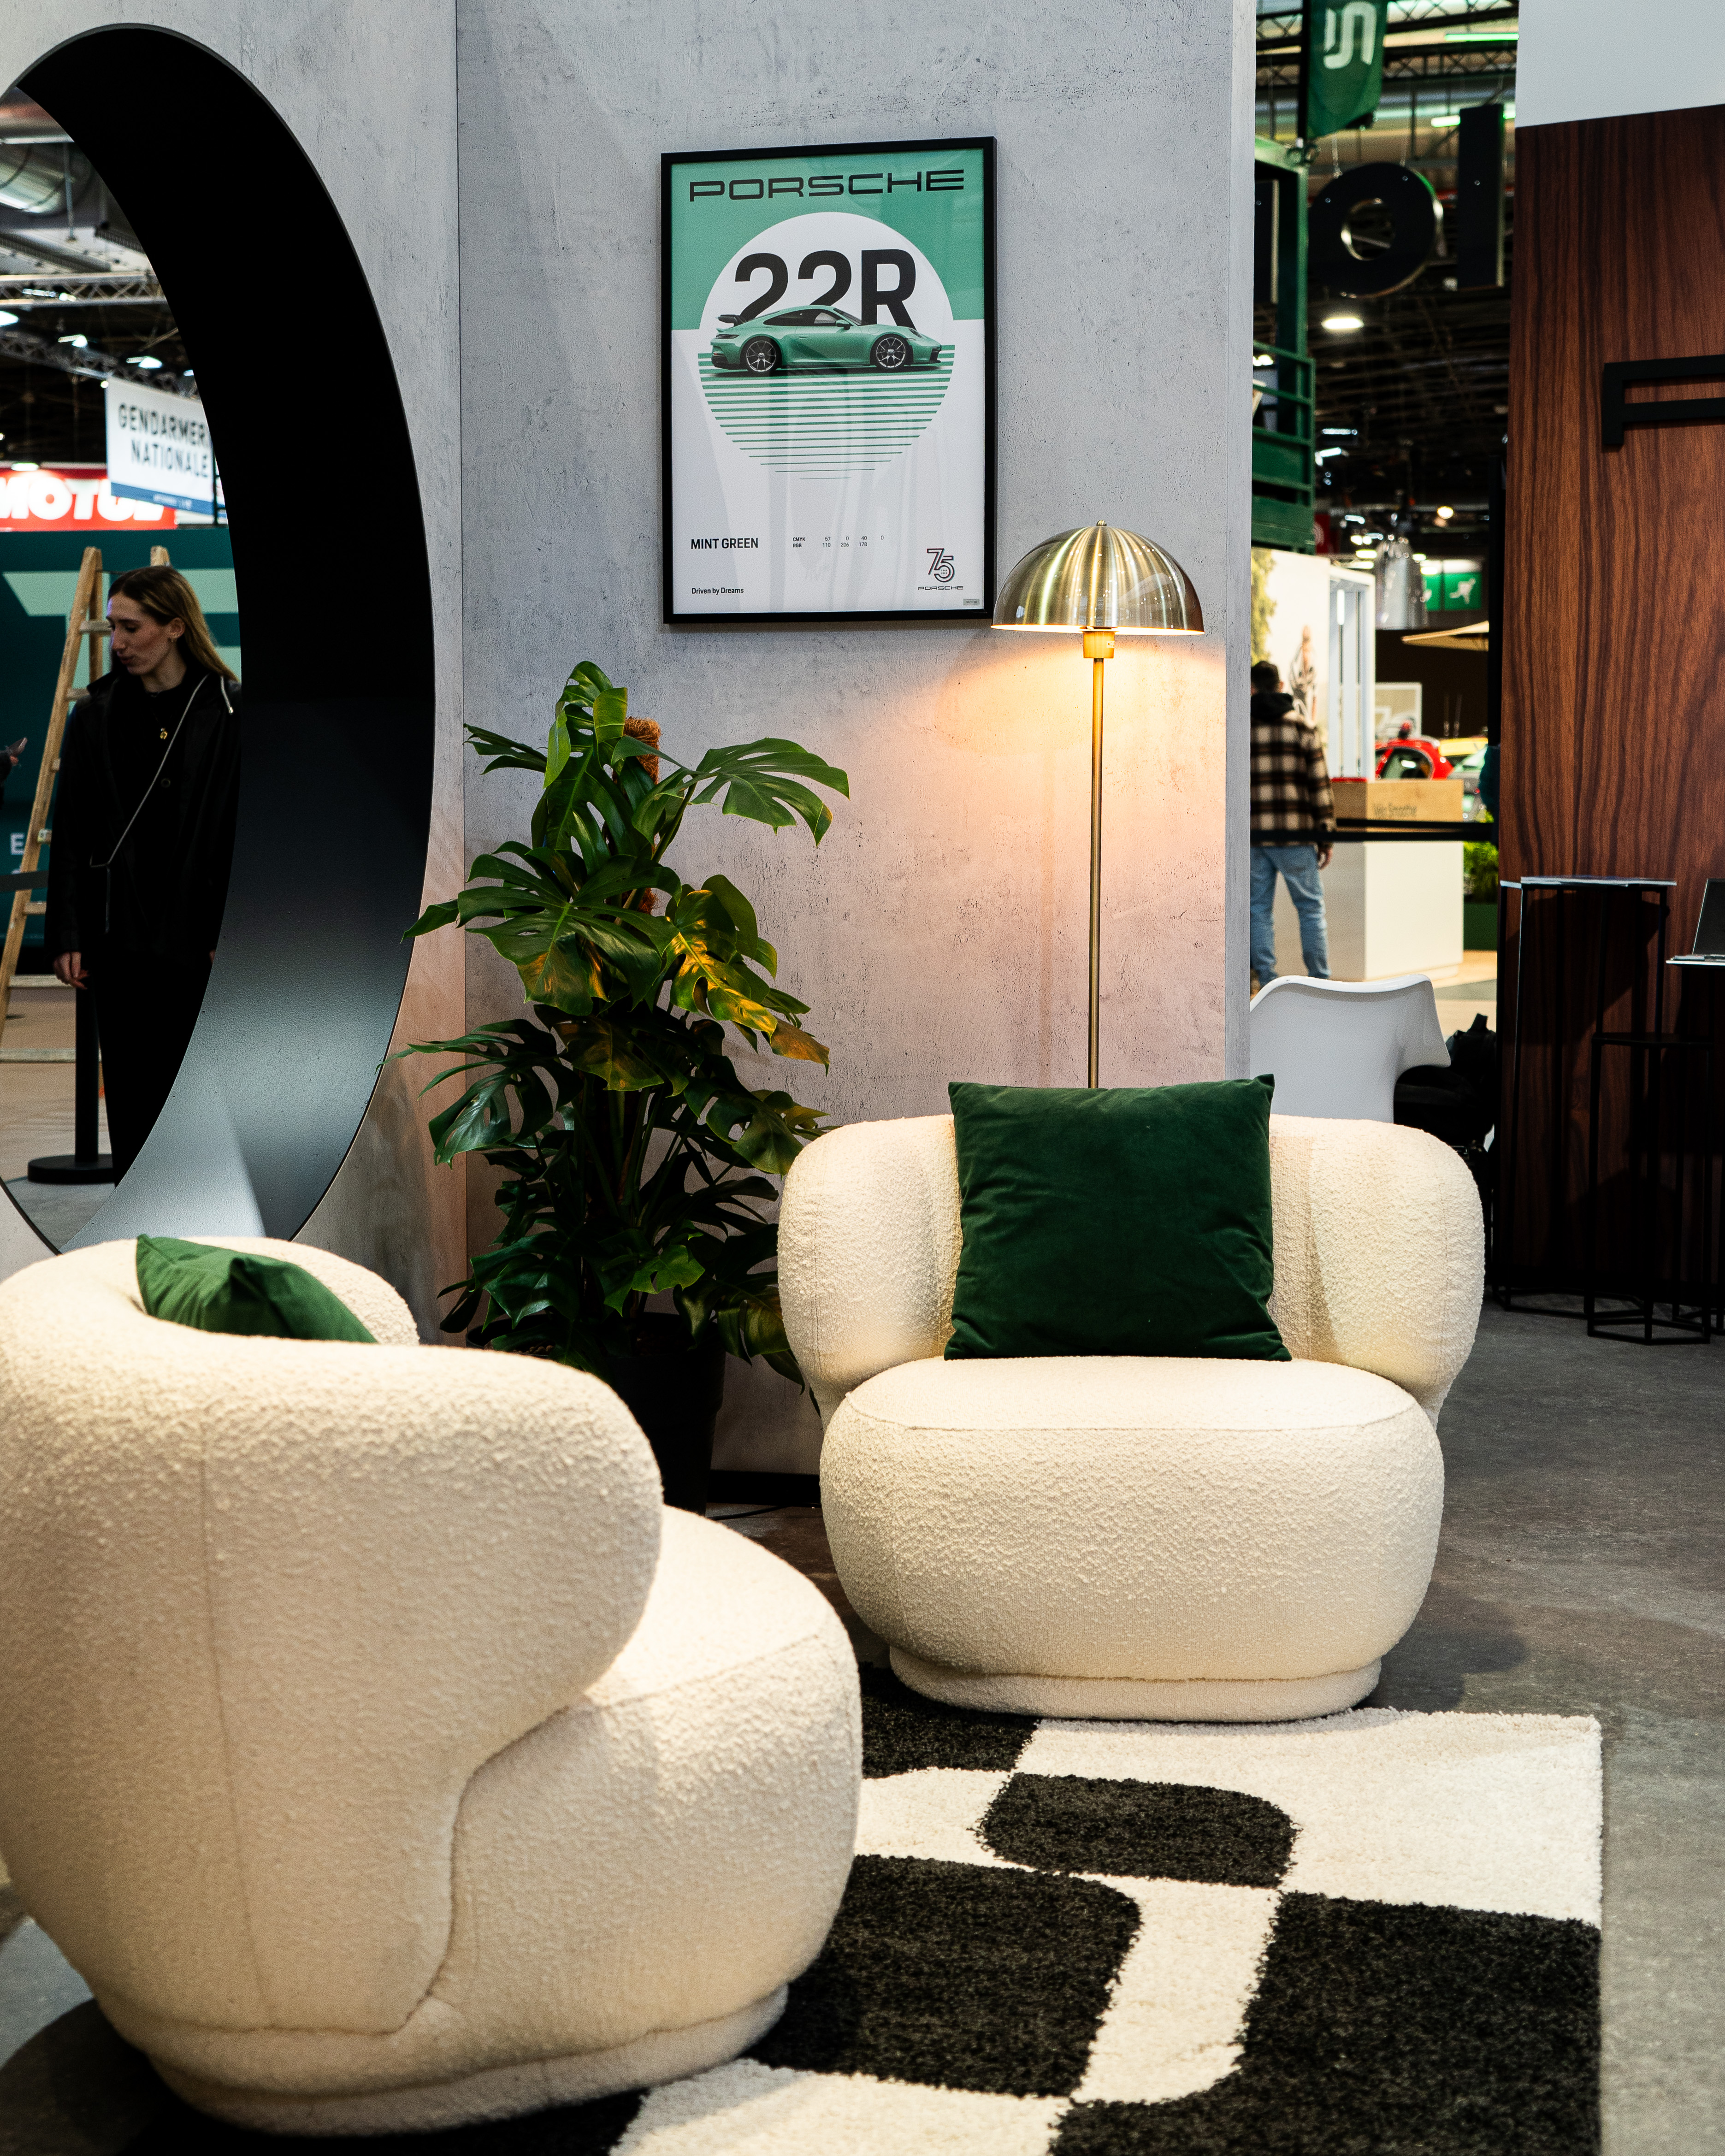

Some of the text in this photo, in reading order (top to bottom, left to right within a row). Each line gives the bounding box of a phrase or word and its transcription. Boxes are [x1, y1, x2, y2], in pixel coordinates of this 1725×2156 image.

[690, 169, 964, 202] PORSCHE
[735, 248, 916, 331] 22R
[131, 438, 208, 477] NATIONALE
[691, 538, 758, 549] MINT GREEN
[926, 548, 955, 583] 75
[712, 587, 720, 596] by
